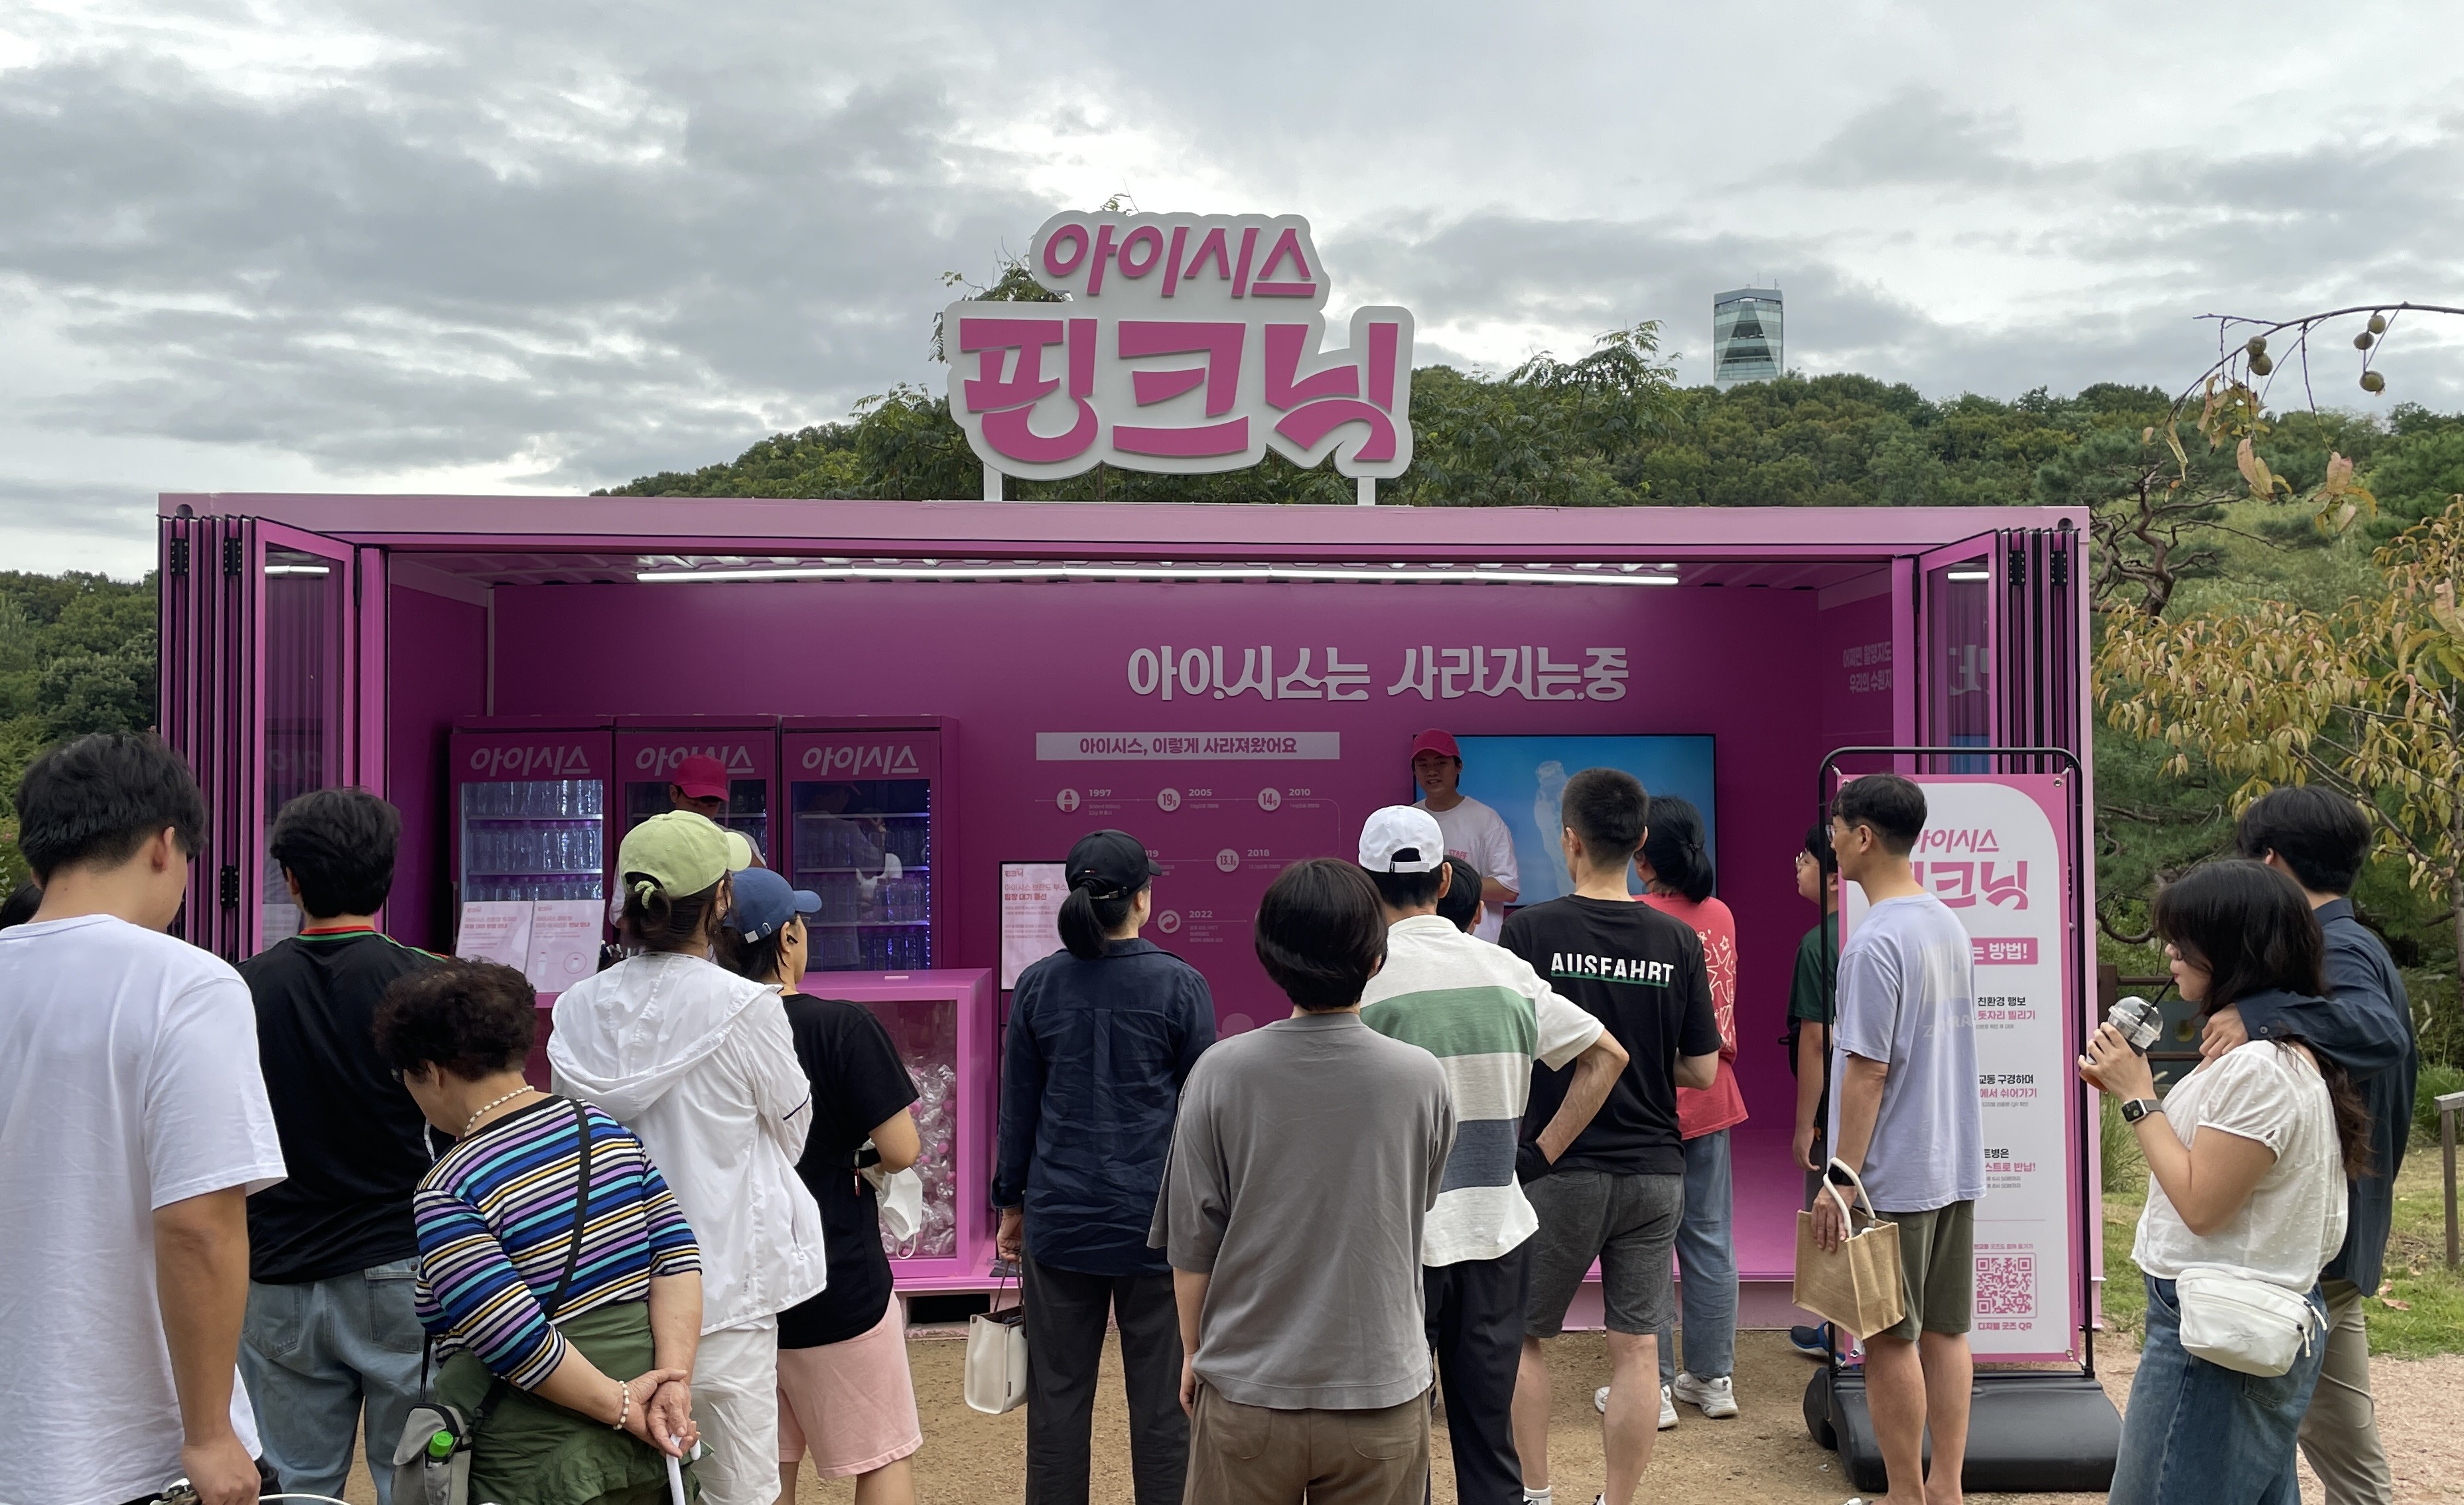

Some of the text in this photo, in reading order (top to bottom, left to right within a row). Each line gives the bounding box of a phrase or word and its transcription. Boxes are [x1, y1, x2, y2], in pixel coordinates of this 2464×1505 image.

[1043, 224, 1318, 298] 아이시스
[960, 318, 1399, 463] 핑크닉
[1079, 737, 1298, 756] 아이시스, 이렇게 사라져왔어요
[470, 746, 590, 777] 아이시스
[802, 745, 920, 776] 아이시스
[1162, 794, 1176, 807] 19g
[1262, 793, 1276, 806] 14g
[1910, 861, 2028, 910] 크닉
[1989, 942, 2027, 960] 방법!
[1551, 952, 1674, 987] AUSFAHRT
[1978, 997, 2026, 1007] 친환경 행보
[1978, 1010, 2035, 1020] 돗자리 빌리기
[1997, 1074, 2033, 1084] 구경하며
[1980, 1088, 2037, 1098] 에서 쉬어가기
[1985, 1163, 2036, 1172] 스트로 반납!
[2018, 1322, 2032, 1330] QR
